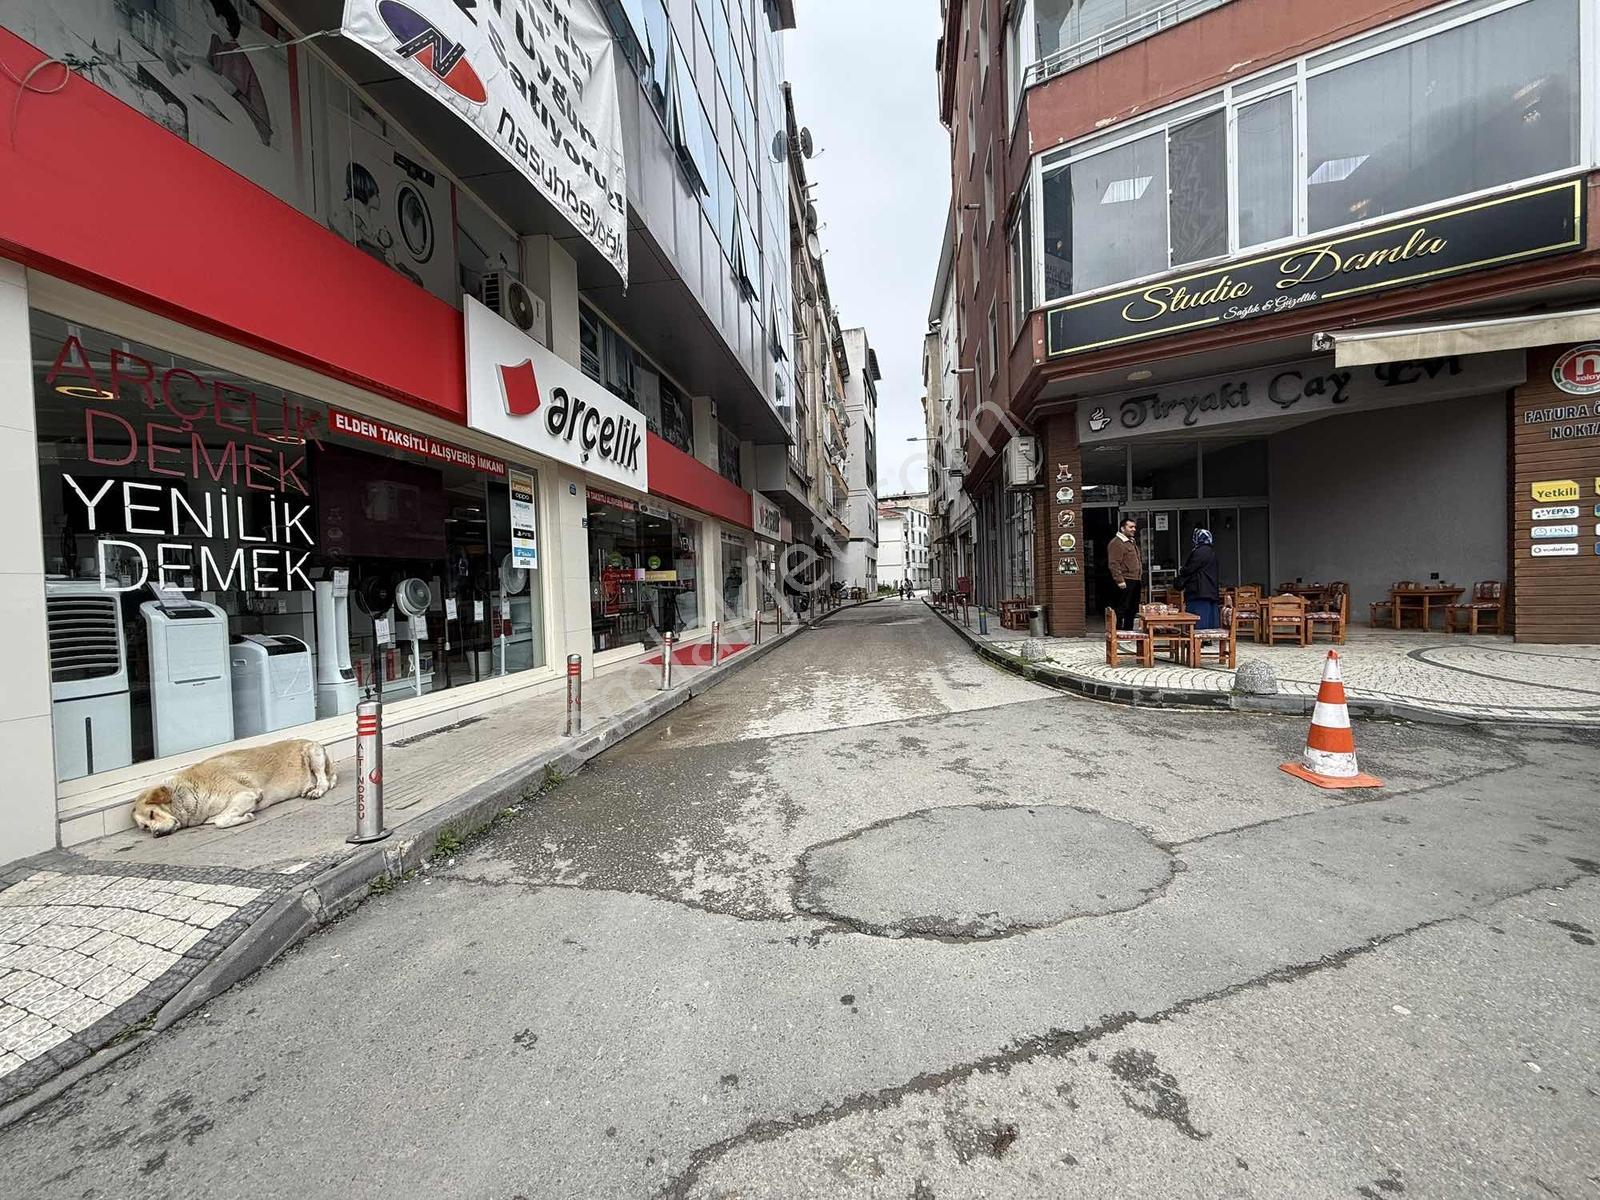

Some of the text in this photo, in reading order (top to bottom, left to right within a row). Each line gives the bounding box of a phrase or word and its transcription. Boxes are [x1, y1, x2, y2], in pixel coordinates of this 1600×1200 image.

[1121, 228, 1448, 322] Studio Damla
[1119, 379, 1251, 428] Tiryaki
[1268, 369, 1352, 409] Çay
[1524, 404, 1588, 424] FATURA
[85, 408, 310, 497] DEMEK
[335, 413, 378, 439] ELDEN
[380, 426, 430, 453] TAKSİTLİ
[430, 442, 476, 469] ALIŞVERİŞ
[544, 386, 642, 472] arçelik
[62, 473, 315, 546] YENİLİK
[1537, 487, 1577, 499] Yetkili
[1546, 507, 1576, 516] YEPAŞ
[98, 538, 317, 593] DEMEK
